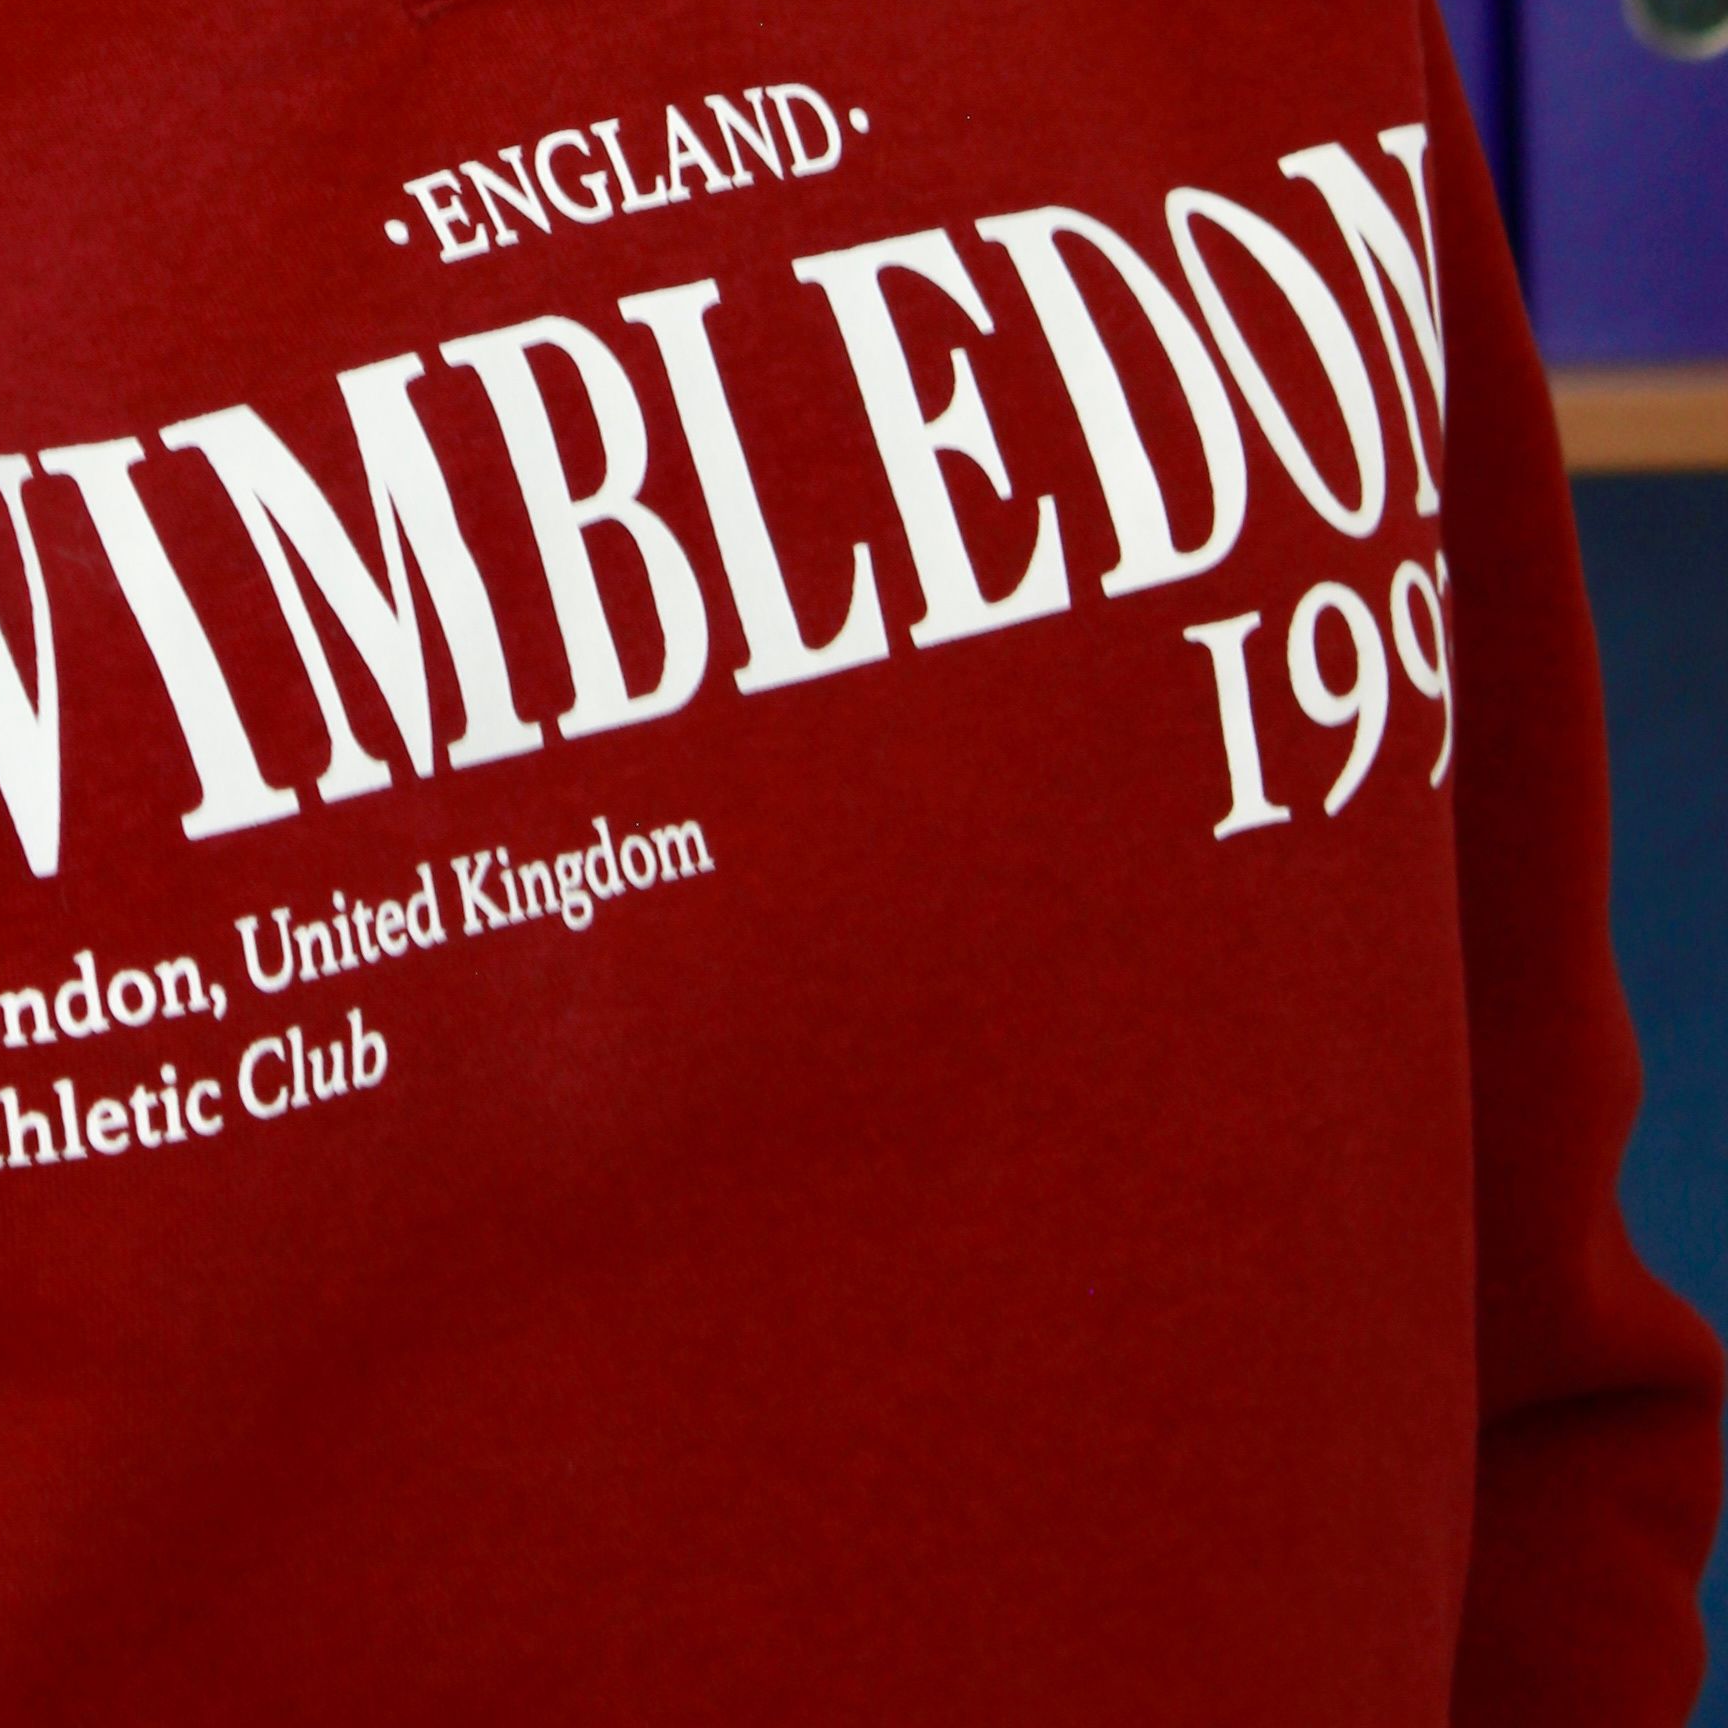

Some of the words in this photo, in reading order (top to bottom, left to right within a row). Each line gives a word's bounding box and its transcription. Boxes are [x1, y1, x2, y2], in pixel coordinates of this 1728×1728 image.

[233, 861, 448, 994] United
[449, 814, 716, 937] Kingdom
[236, 1006, 389, 1120] Club
